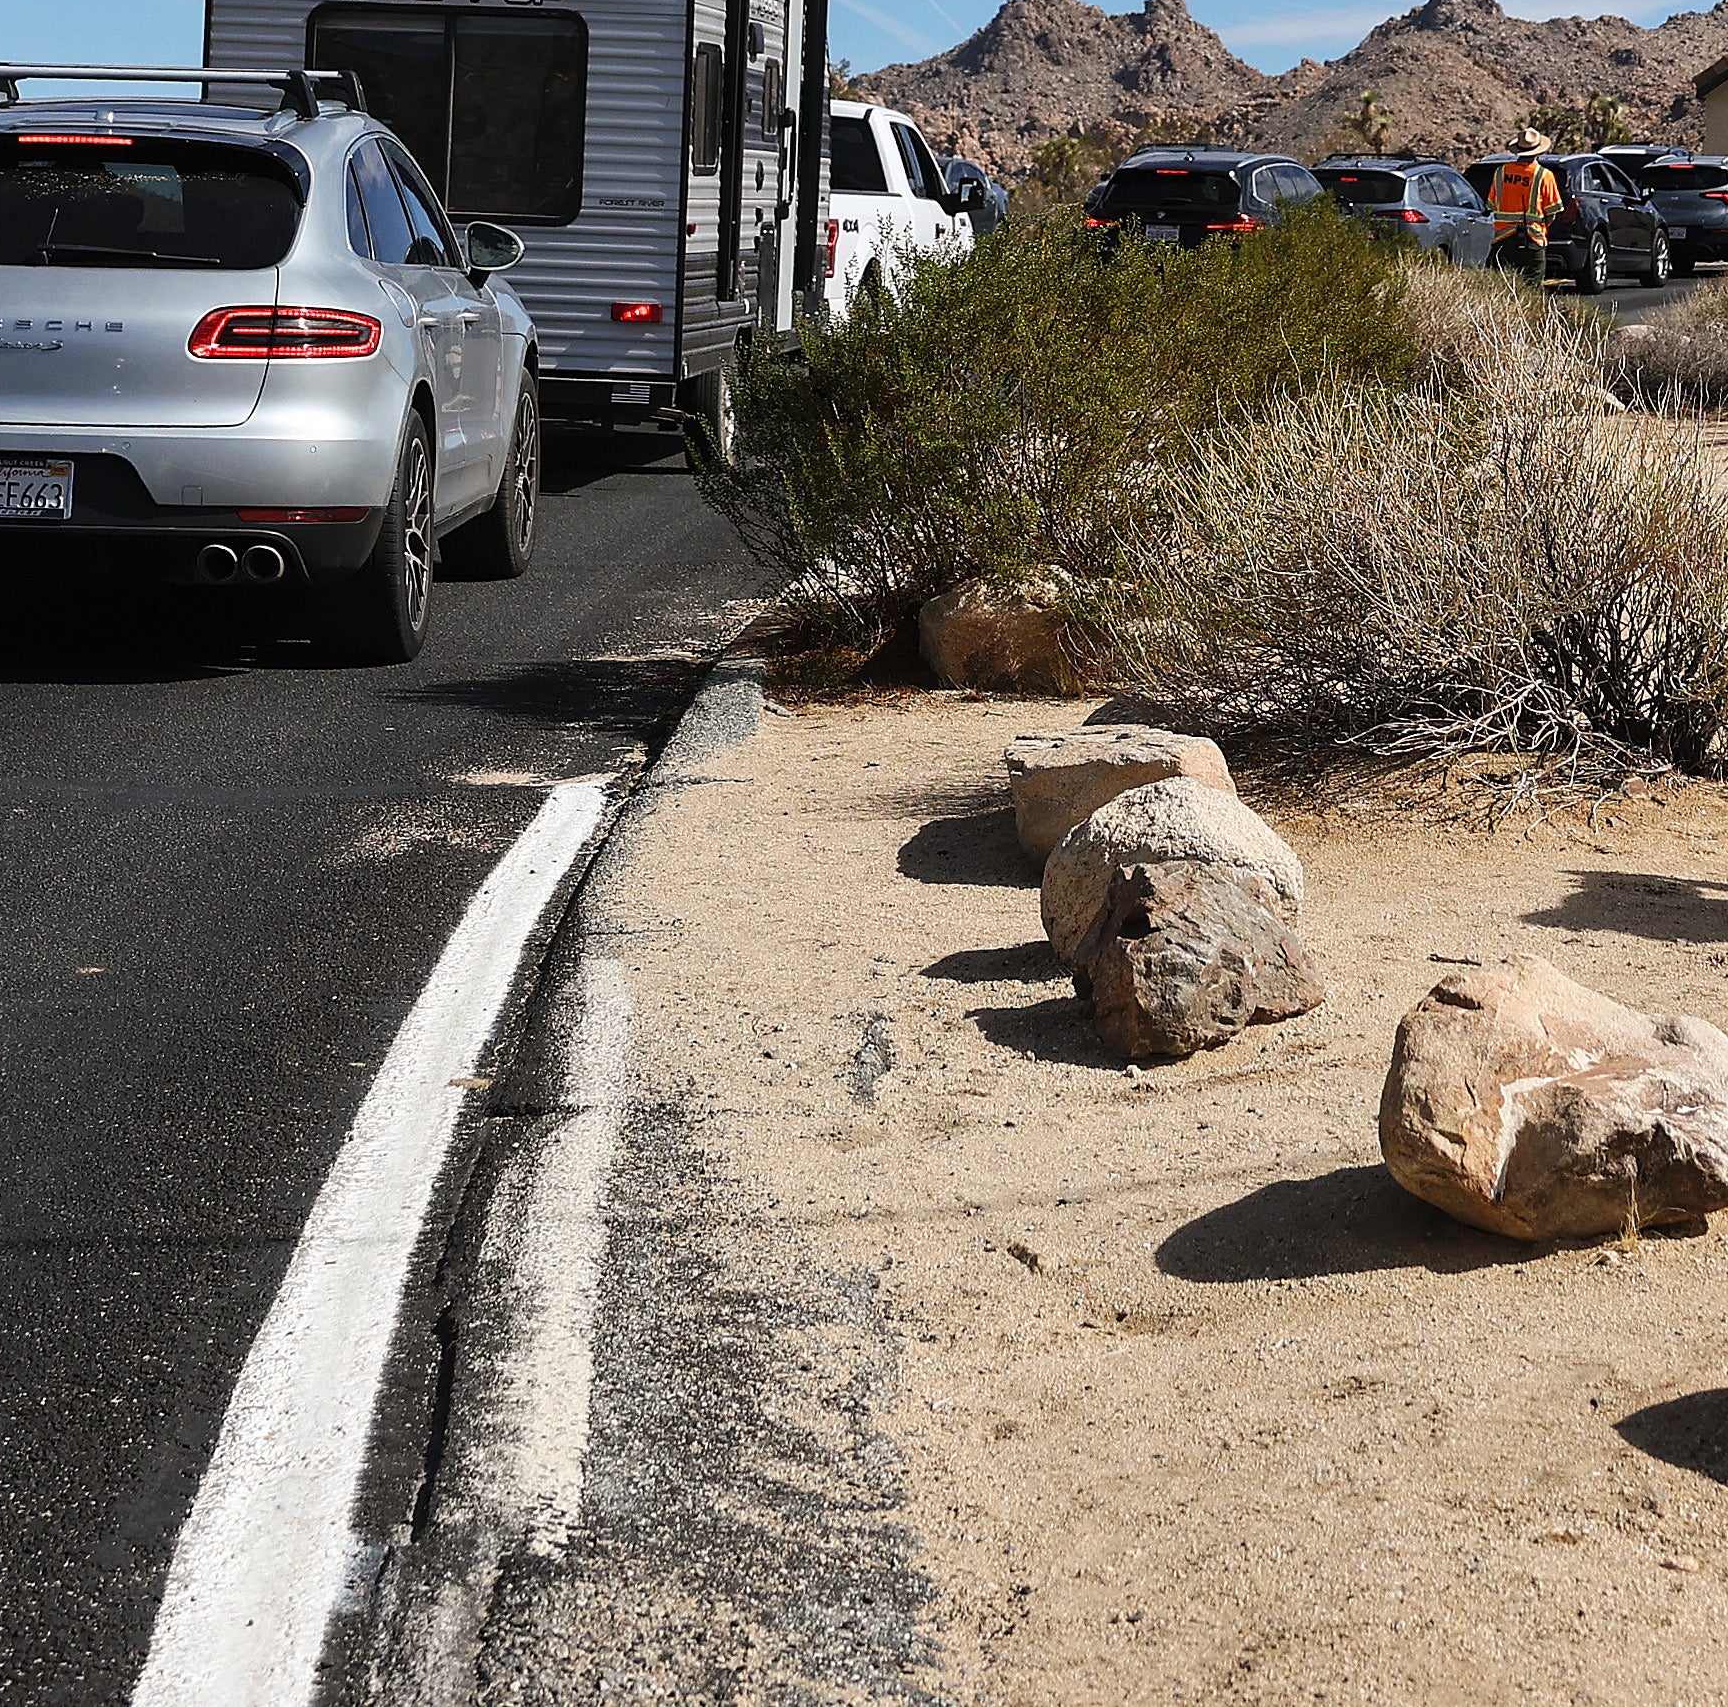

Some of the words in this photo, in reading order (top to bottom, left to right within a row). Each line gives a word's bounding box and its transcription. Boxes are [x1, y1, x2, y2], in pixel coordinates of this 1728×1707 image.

[1503, 173, 1530, 187] NPS
[599, 198, 636, 207] FOREST
[638, 199, 666, 207] RIVER
[19, 459, 44, 467] CREEK
